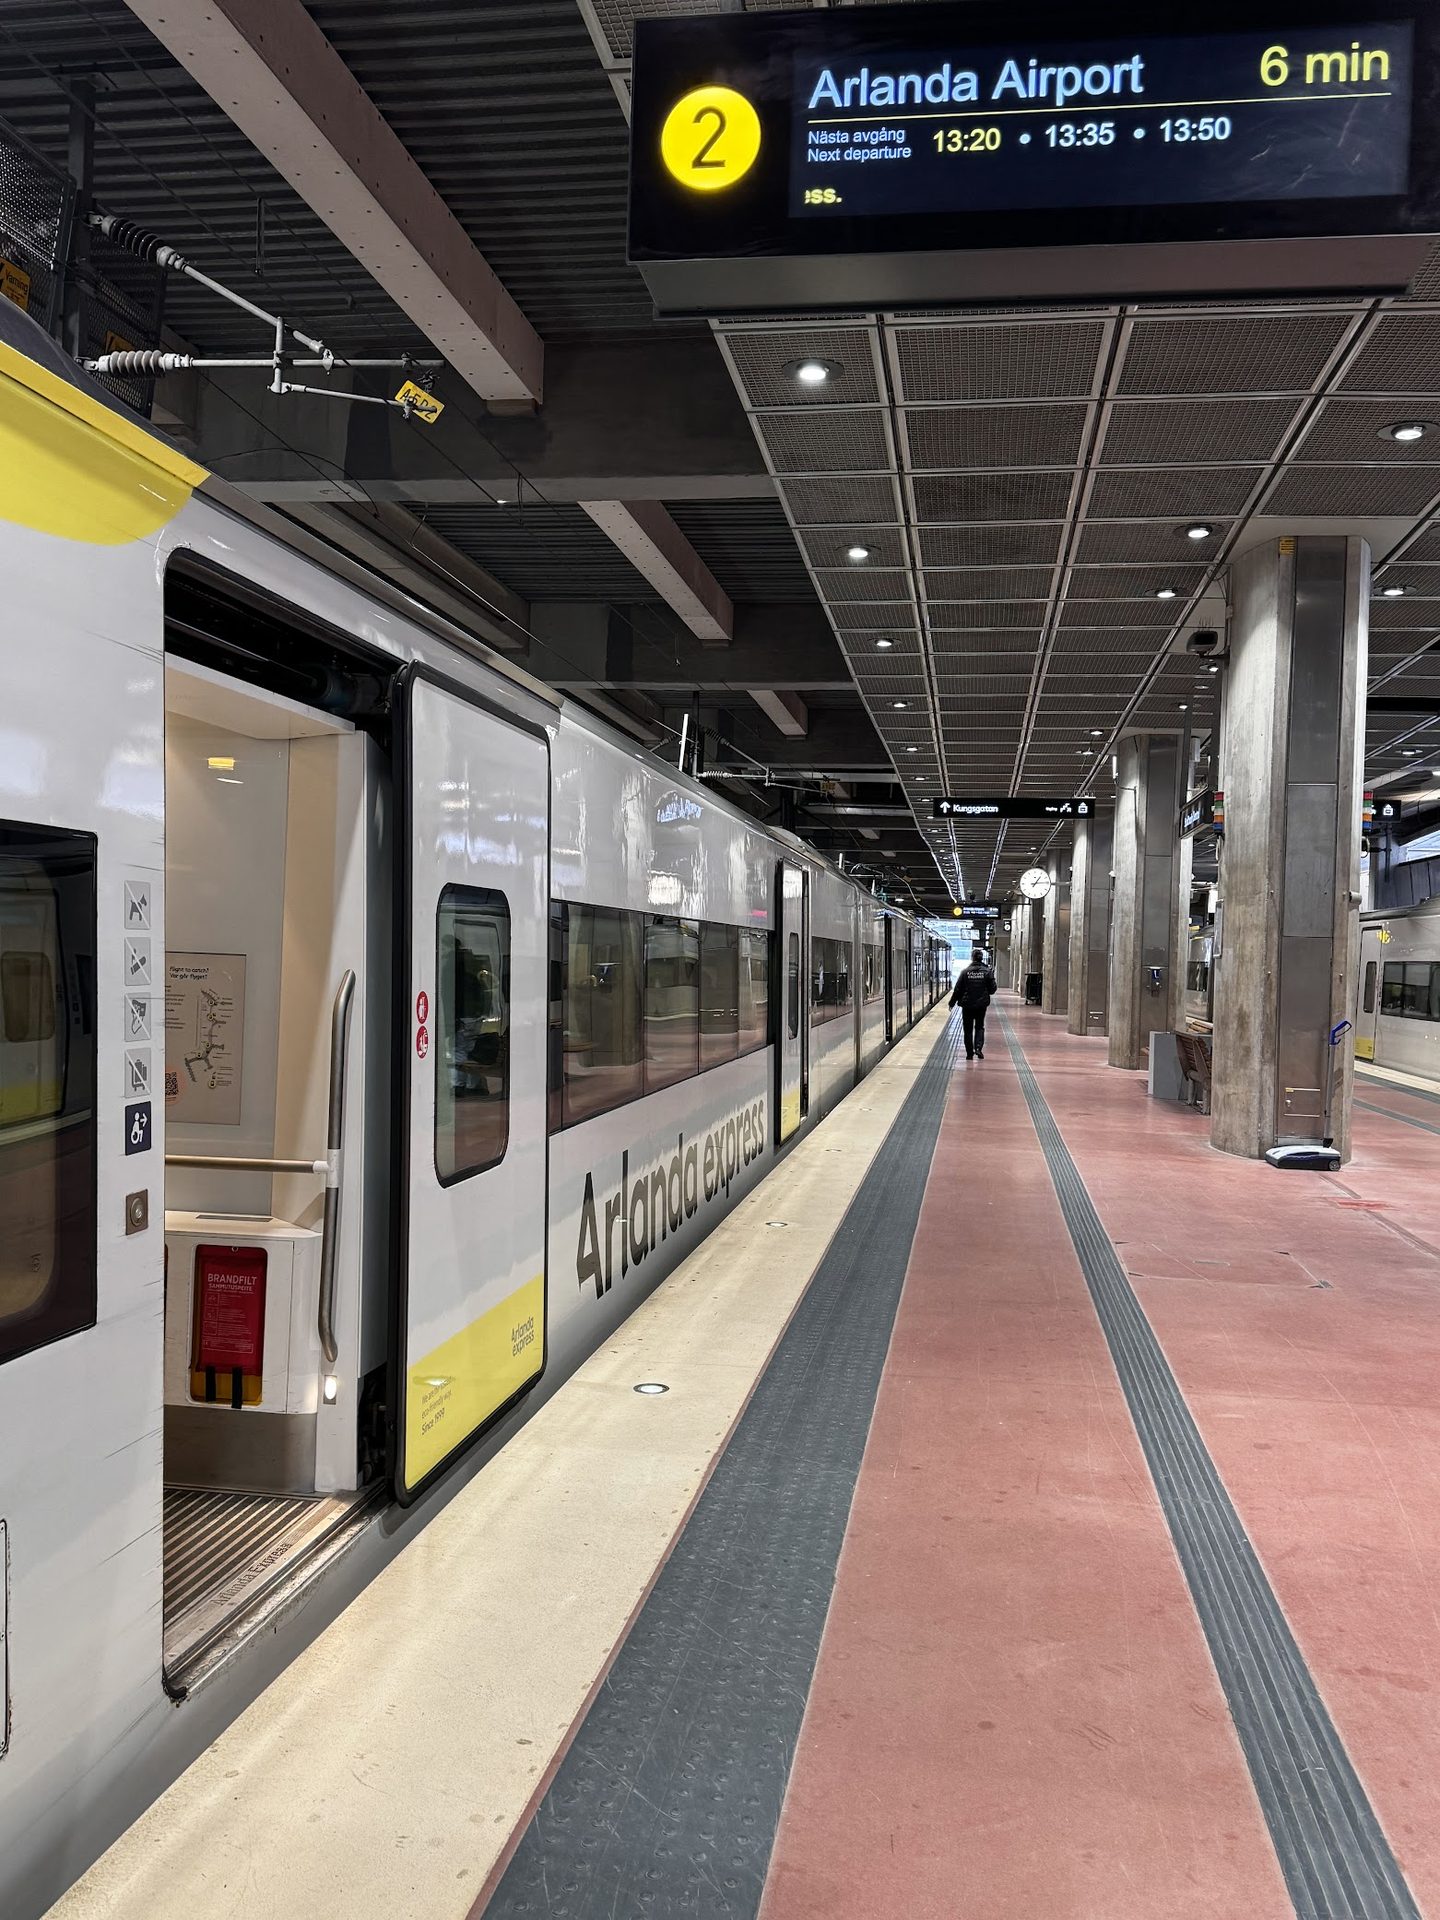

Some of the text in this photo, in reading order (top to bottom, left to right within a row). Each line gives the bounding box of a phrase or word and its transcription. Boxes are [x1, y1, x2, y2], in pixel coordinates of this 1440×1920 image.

[809, 43, 1389, 109] Arlanda Airport 6 min
[692, 106, 726, 169] 2
[808, 127, 905, 144] Nästa avgång
[933, 117, 1231, 152] 13:20 13:35 13:50
[808, 146, 911, 163] Next departure
[953, 804, 999, 814] Kungsgatan
[576, 1099, 764, 1300] Arlanda express
[207, 1273, 257, 1286] BRANDFILT
[511, 1316, 534, 1343] Arlanda
[512, 1329, 535, 1357] express
[249, 1543, 293, 1574] Express
